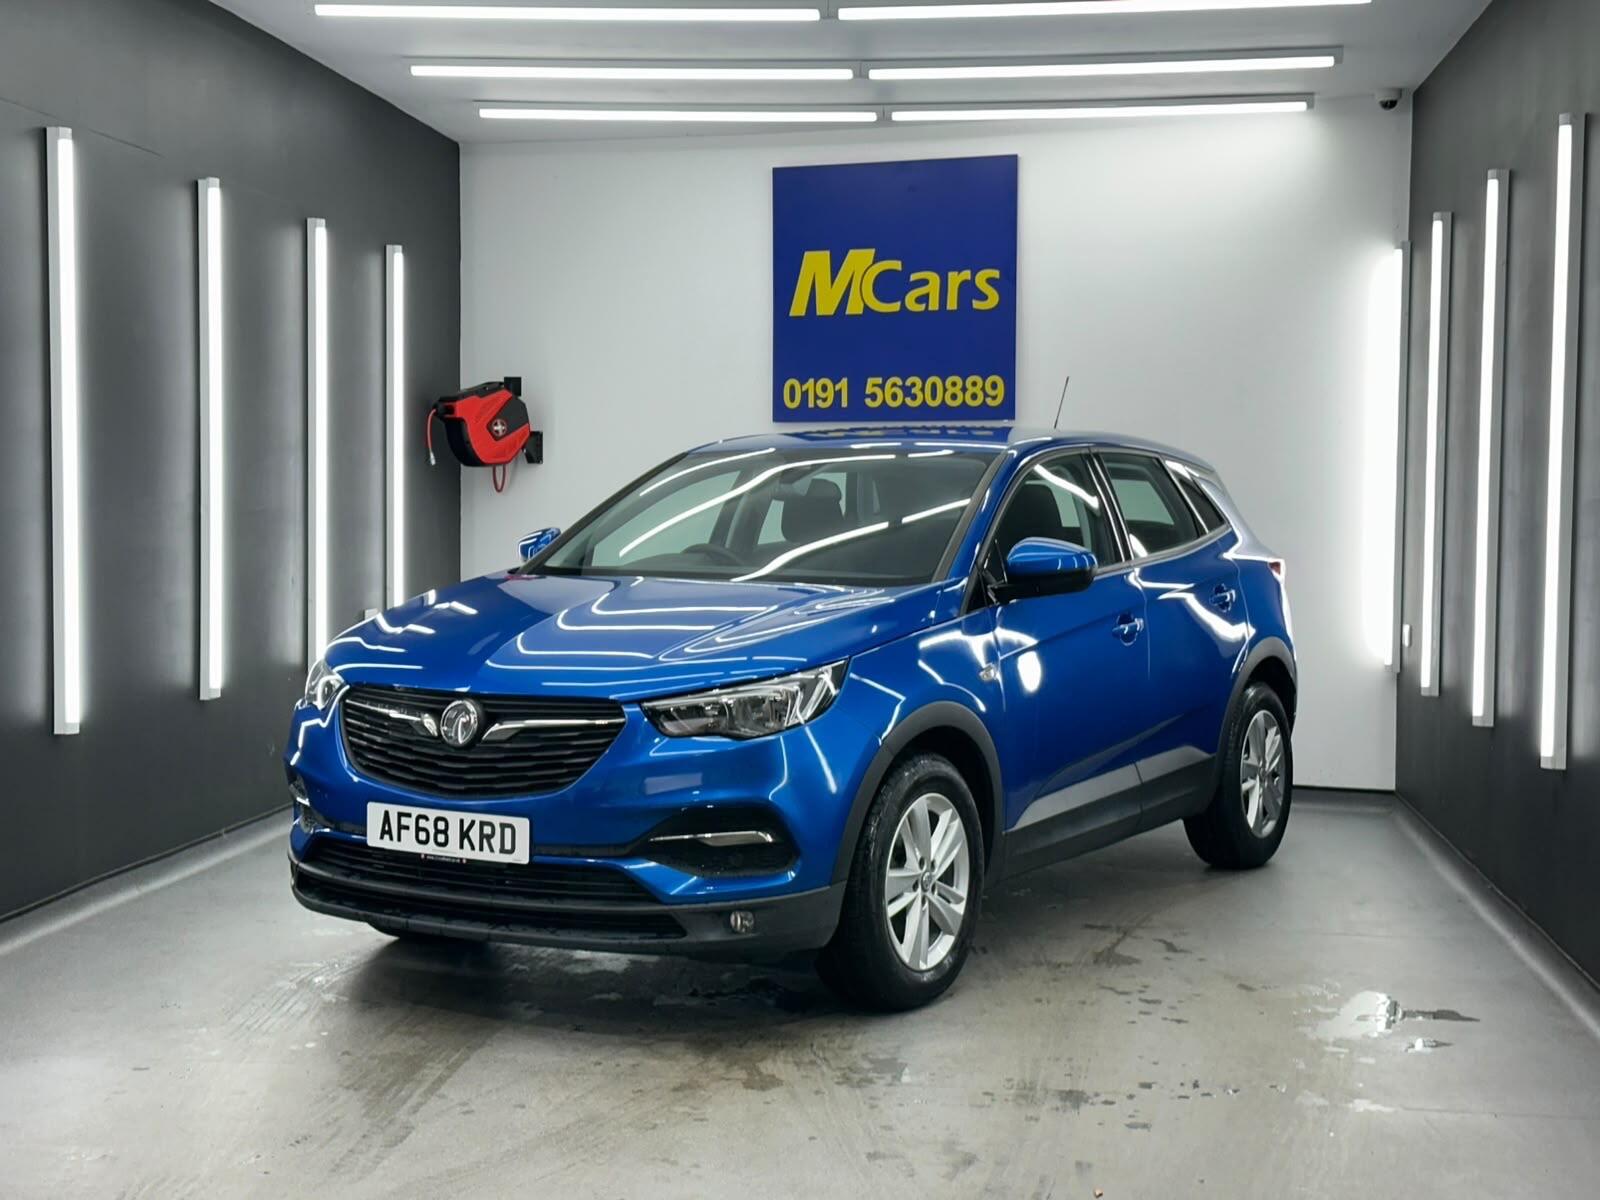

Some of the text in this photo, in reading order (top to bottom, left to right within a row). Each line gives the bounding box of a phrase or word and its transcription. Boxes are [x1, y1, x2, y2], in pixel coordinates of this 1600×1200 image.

[783, 374, 1005, 409] 0191 5630889
[379, 809, 517, 855] AF68 KRD
